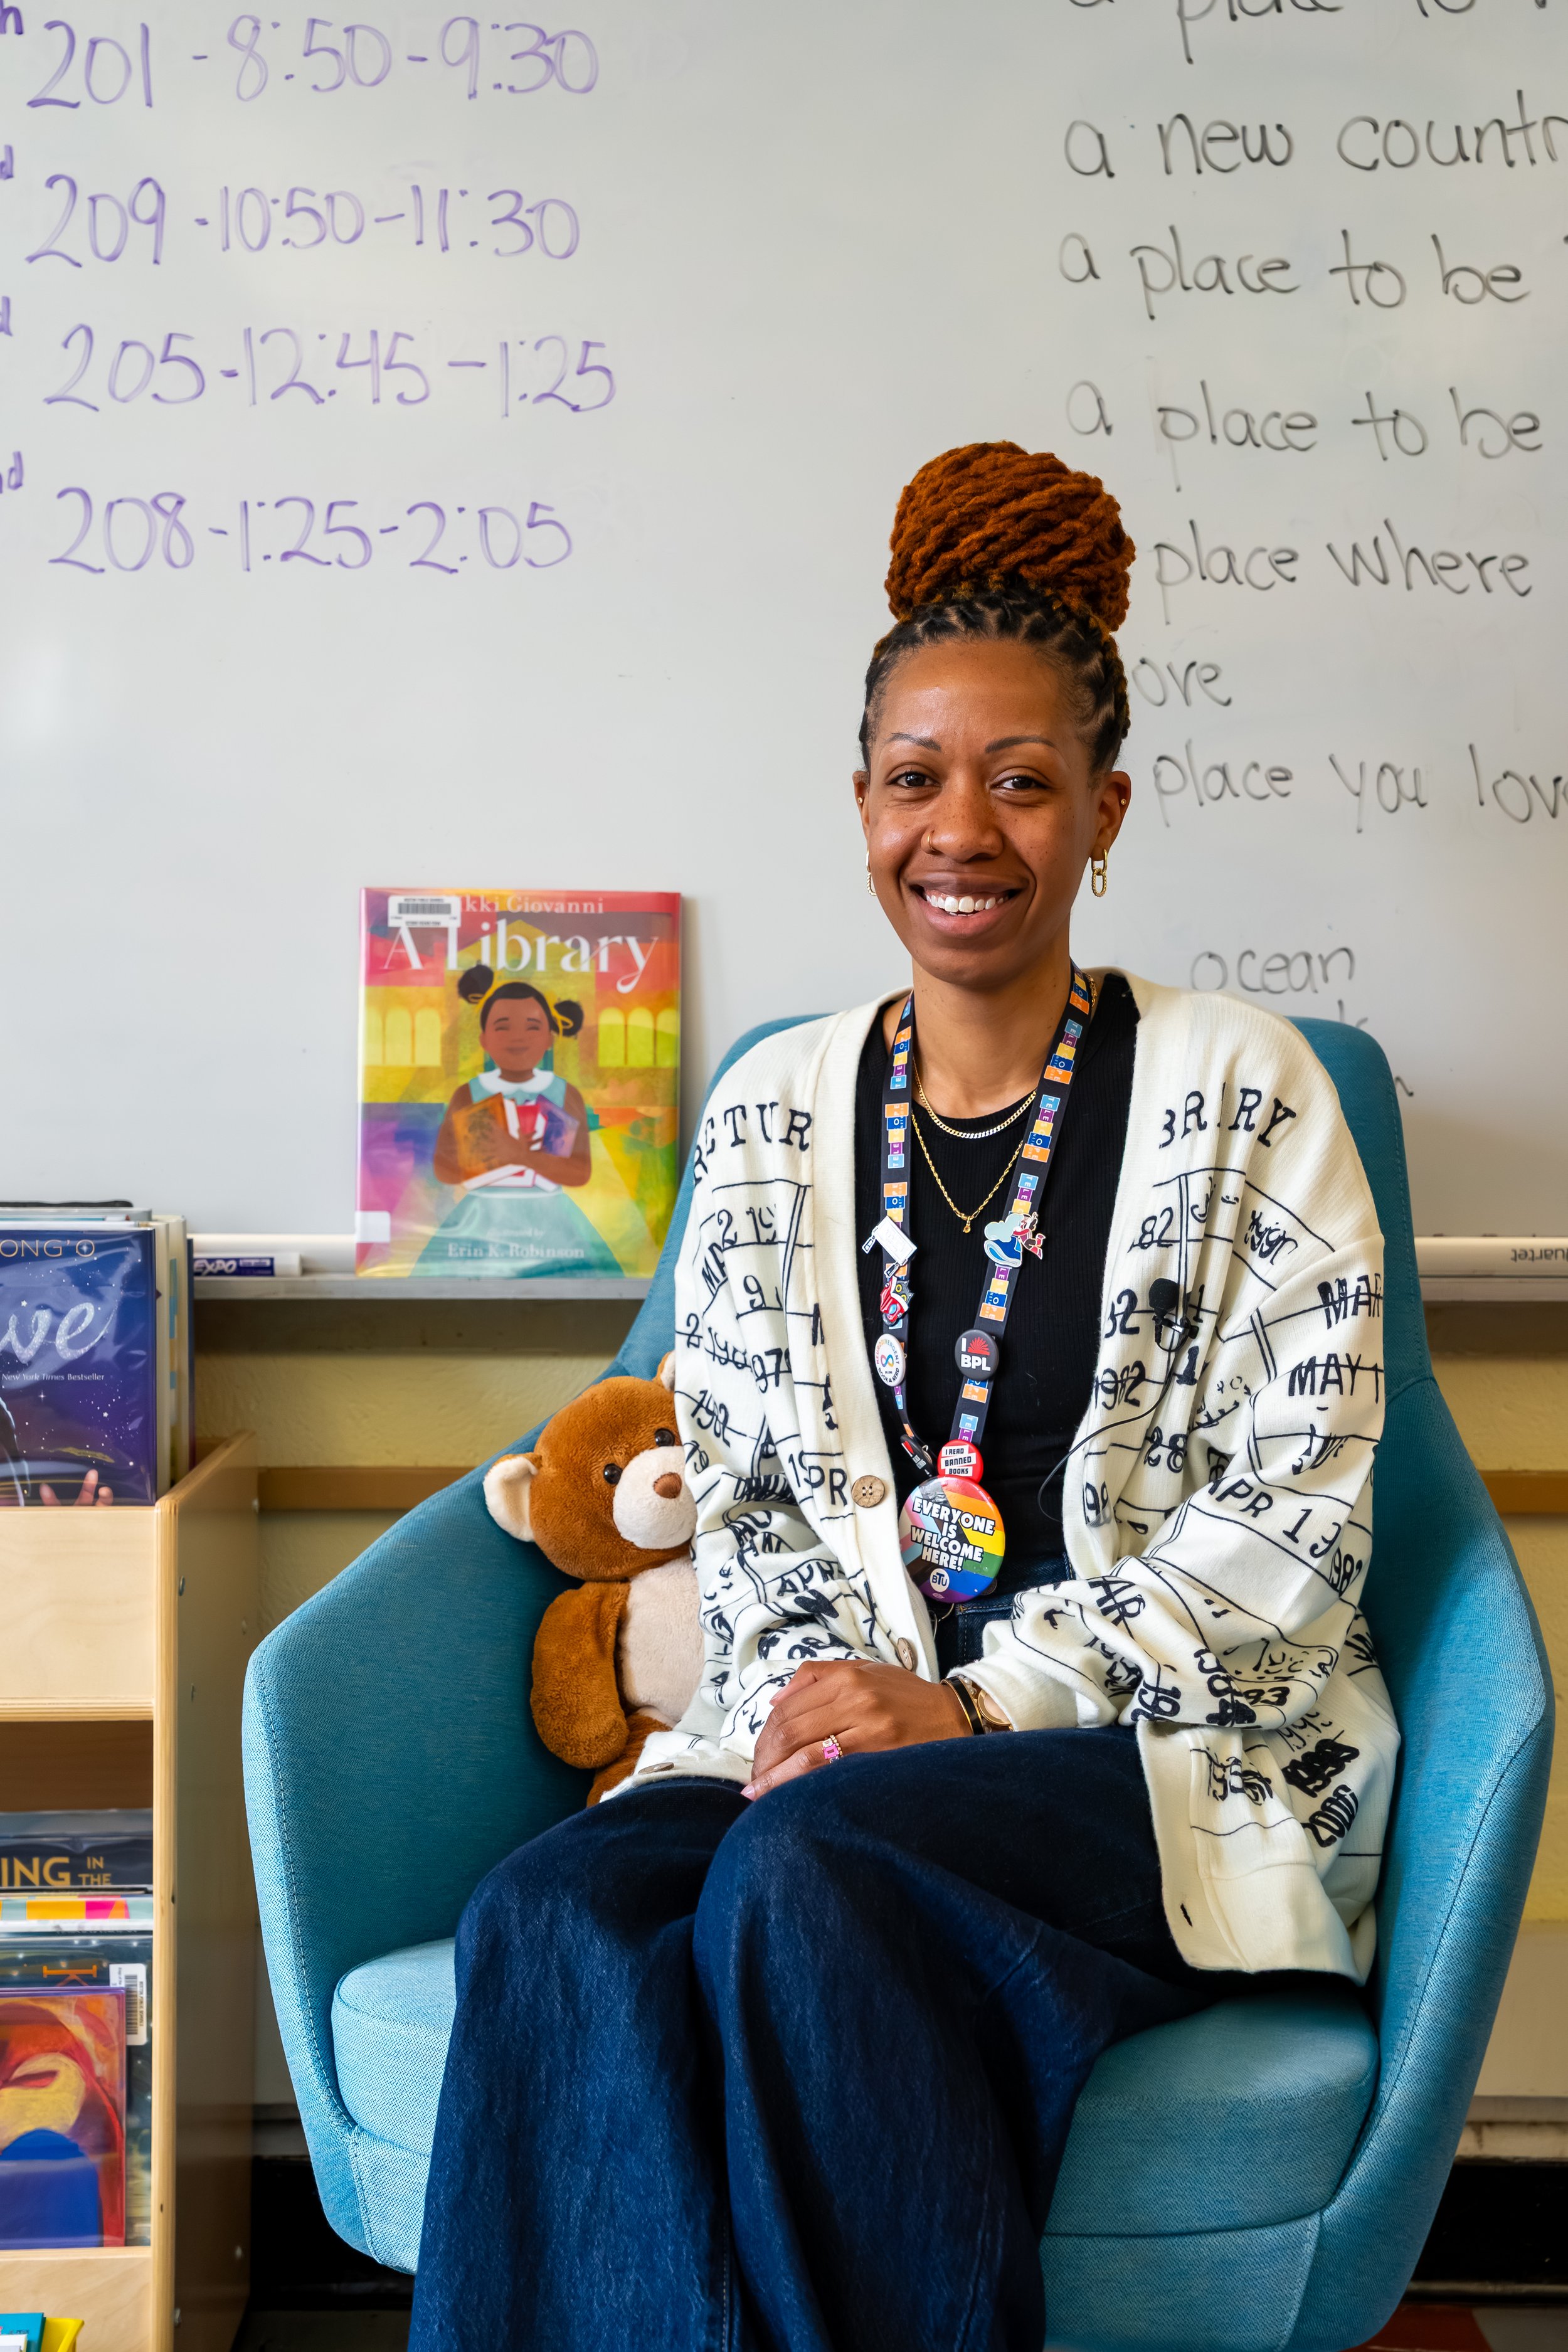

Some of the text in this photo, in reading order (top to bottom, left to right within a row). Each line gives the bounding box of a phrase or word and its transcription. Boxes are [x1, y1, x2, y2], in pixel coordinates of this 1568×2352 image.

[26, 20, 152, 107] 201
[1063, 119, 1115, 178] a
[1157, 113, 1294, 175] new
[24, 172, 166, 268] 209
[1057, 225, 1532, 320] a place to be
[1066, 379, 1544, 493] a place to be
[1153, 517, 1534, 625] place where
[1152, 738, 1293, 828] place
[1328, 752, 1428, 834] you
[507, 895, 604, 914] Giovanni
[384, 926, 424, 970] A
[1190, 946, 1355, 995] ocean
[448, 1242, 484, 1258] Erin
[509, 1242, 585, 1259] Robinson
[1510, 1248, 1568, 1263] uartet
[194, 1258, 237, 1276] EXPO
[961, 1337, 967, 1352] I
[960, 1353, 991, 1372] BPL
[945, 1456, 972, 1467] BANNED
[913, 1496, 995, 1535] EVERYONE
[911, 1525, 984, 1563] WELCOME
[942, 1522, 957, 1539] IS
[921, 1545, 964, 1573] HERE!
[931, 1572, 948, 1587] BTU
[87, 1856, 103, 1870] IN
[78, 1873, 112, 1885] THE
